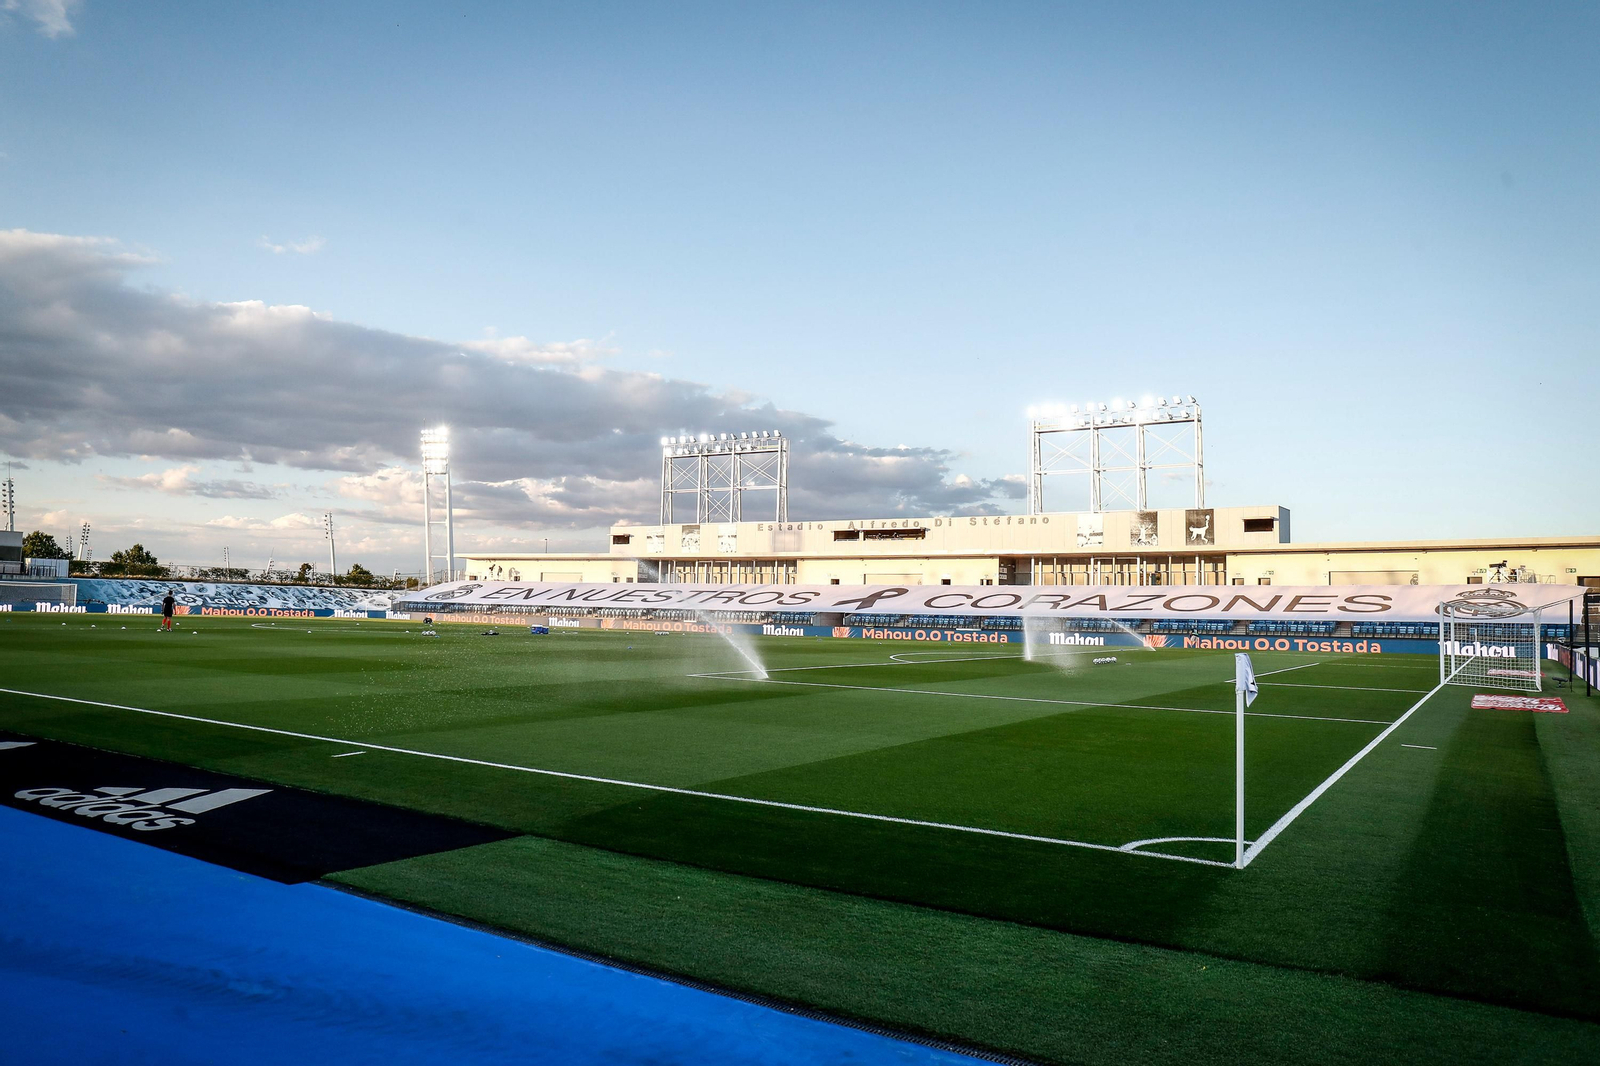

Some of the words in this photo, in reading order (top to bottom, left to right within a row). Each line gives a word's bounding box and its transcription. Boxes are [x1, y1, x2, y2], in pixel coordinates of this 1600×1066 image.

[757, 523, 823, 531] Estadio
[848, 520, 920, 530] Alfredo
[934, 517, 952, 527] Di
[969, 516, 1050, 526] Stéfano
[203, 596, 260, 606] LaLiga
[480, 587, 550, 600] EN
[548, 588, 820, 605] NUESTROS
[924, 593, 1393, 612] CORAZONES
[36, 602, 87, 613] Mahou
[107, 604, 153, 614] Mahou
[201, 607, 244, 617] Mahou
[269, 608, 315, 617] Tostada
[334, 609, 368, 618] Mahou
[386, 611, 410, 620] Mahou
[443, 614, 473, 623] Mahou
[490, 616, 526, 625] Tostada
[549, 617, 580, 627] Mahou
[623, 621, 661, 631] Mahou
[684, 623, 733, 634] Tostada
[763, 624, 804, 636] Mahou
[862, 628, 912, 640] Mahou
[944, 631, 1008, 643] Tostada
[1049, 632, 1104, 646] Mahou
[1183, 636, 1250, 650] Mahou
[1294, 639, 1381, 653] Tostada
[14, 787, 196, 831] adidas
